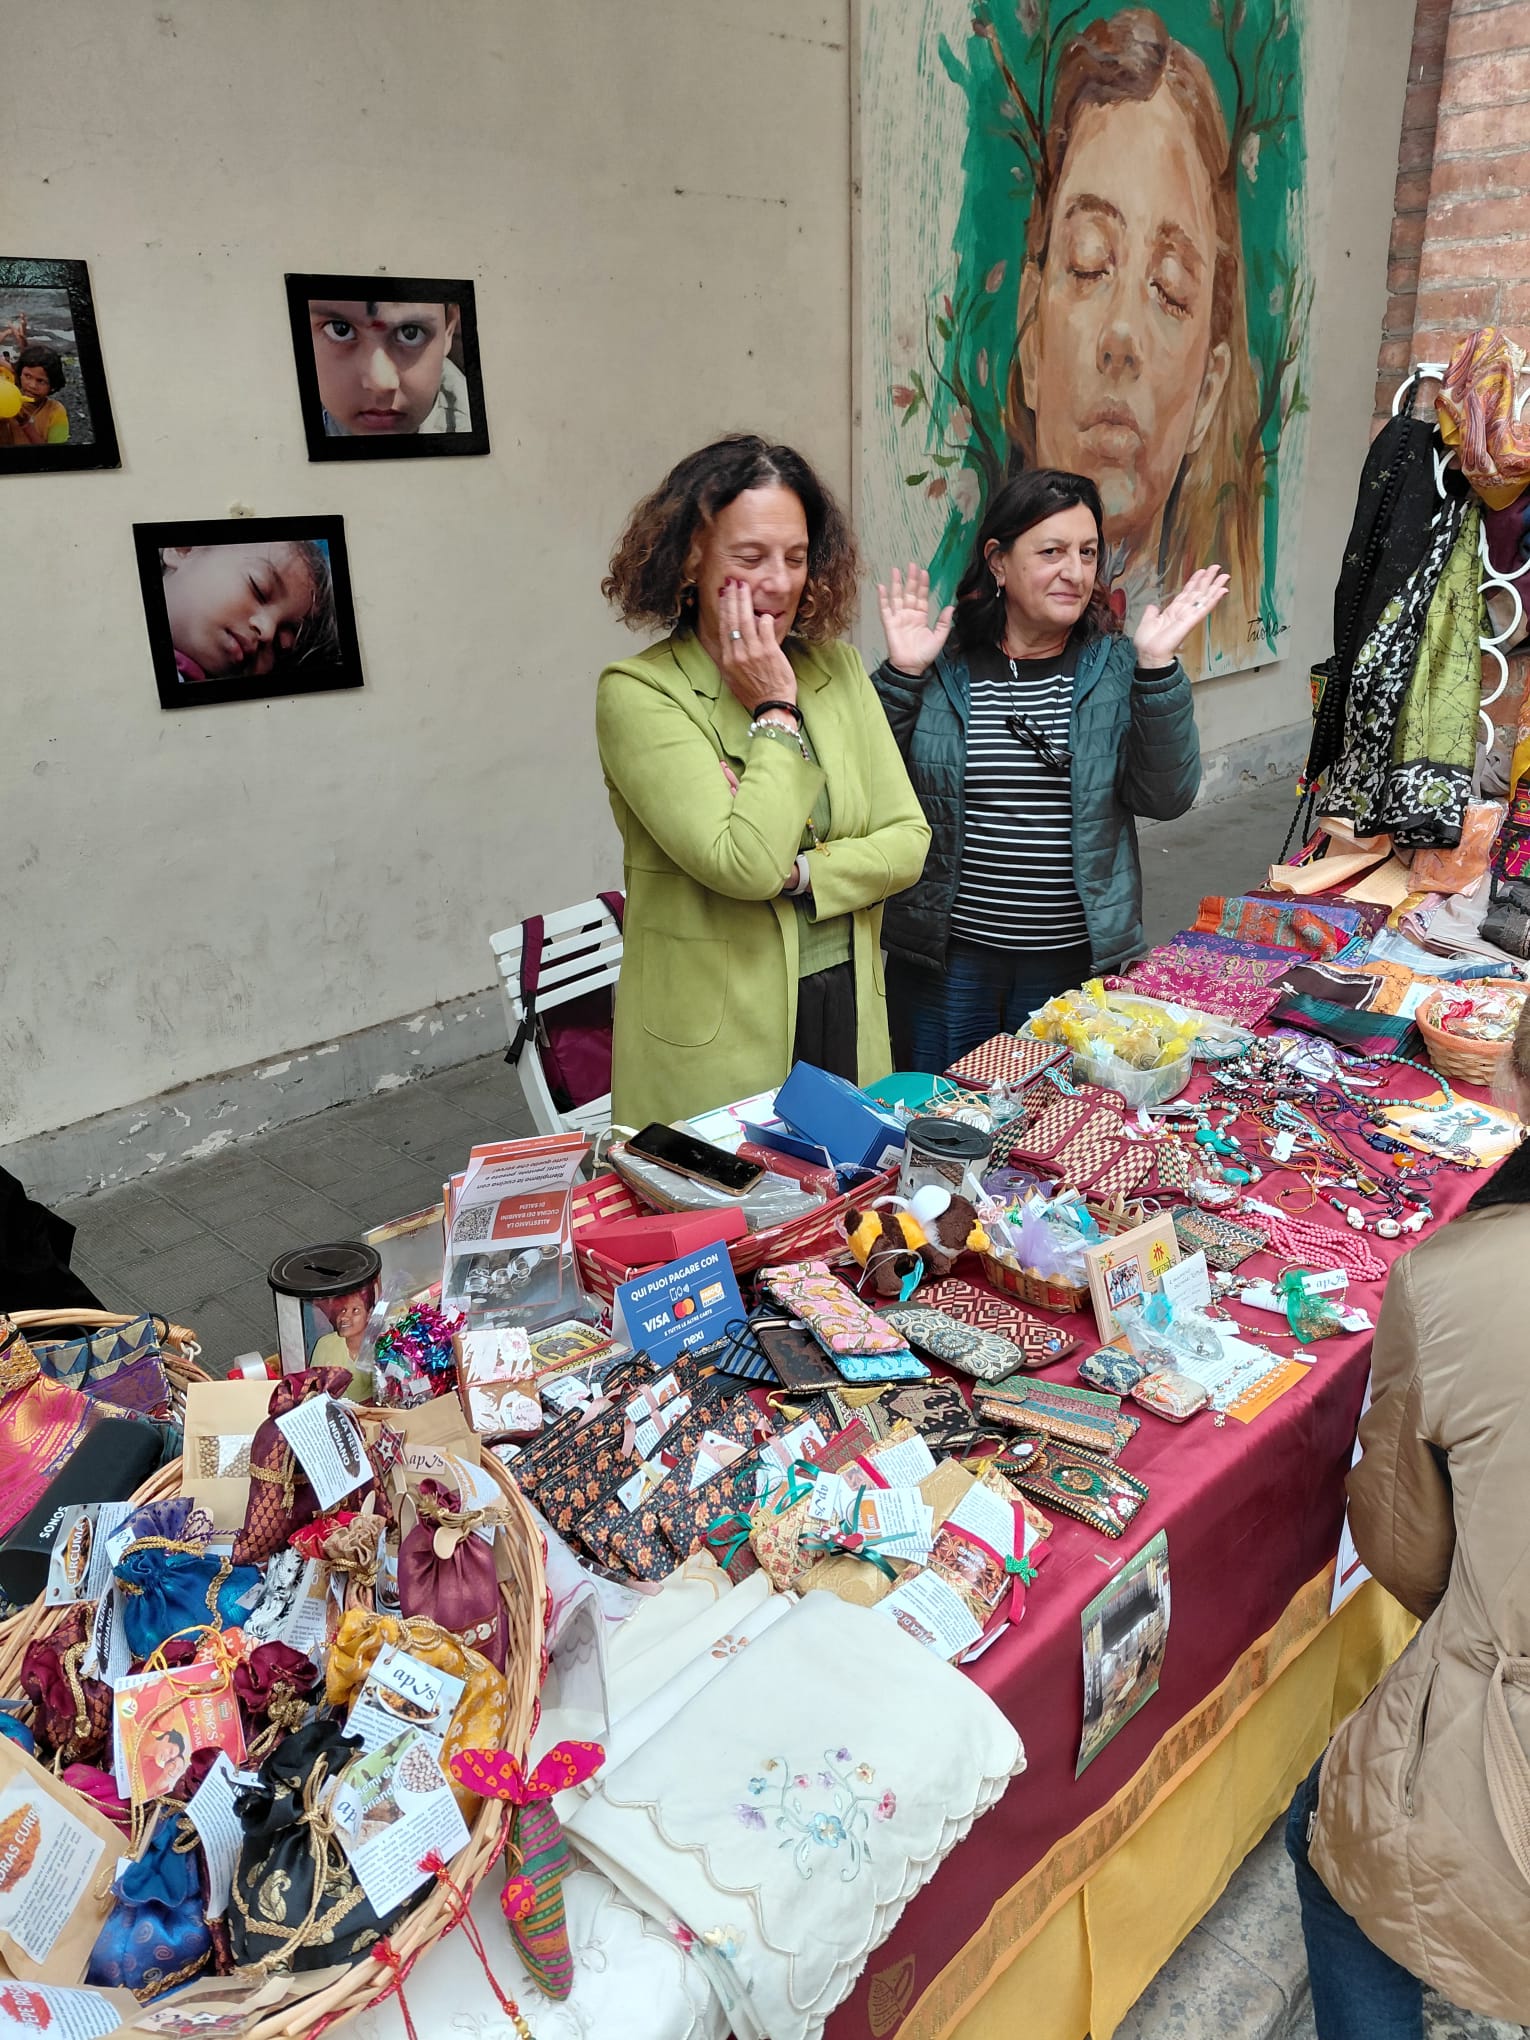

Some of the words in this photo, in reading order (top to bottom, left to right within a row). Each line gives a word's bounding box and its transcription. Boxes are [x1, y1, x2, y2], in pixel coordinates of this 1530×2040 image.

[537, 1209, 559, 1217] CUCINA
[630, 1288, 648, 1302] QUI
[647, 1277, 669, 1294] PUOI
[668, 1262, 701, 1284] PAGARE
[700, 1253, 719, 1268] CON
[642, 1312, 671, 1333] VISA
[683, 1330, 705, 1347] nexi
[328, 1419, 350, 1467] INDIANO
[346, 1432, 361, 1462] NERO
[39, 1506, 68, 1539] SONOS
[66, 1521, 85, 1587] CURCUMA
[103, 1607, 113, 1660] INDIANO
[0, 1843, 20, 1886] DRAS
